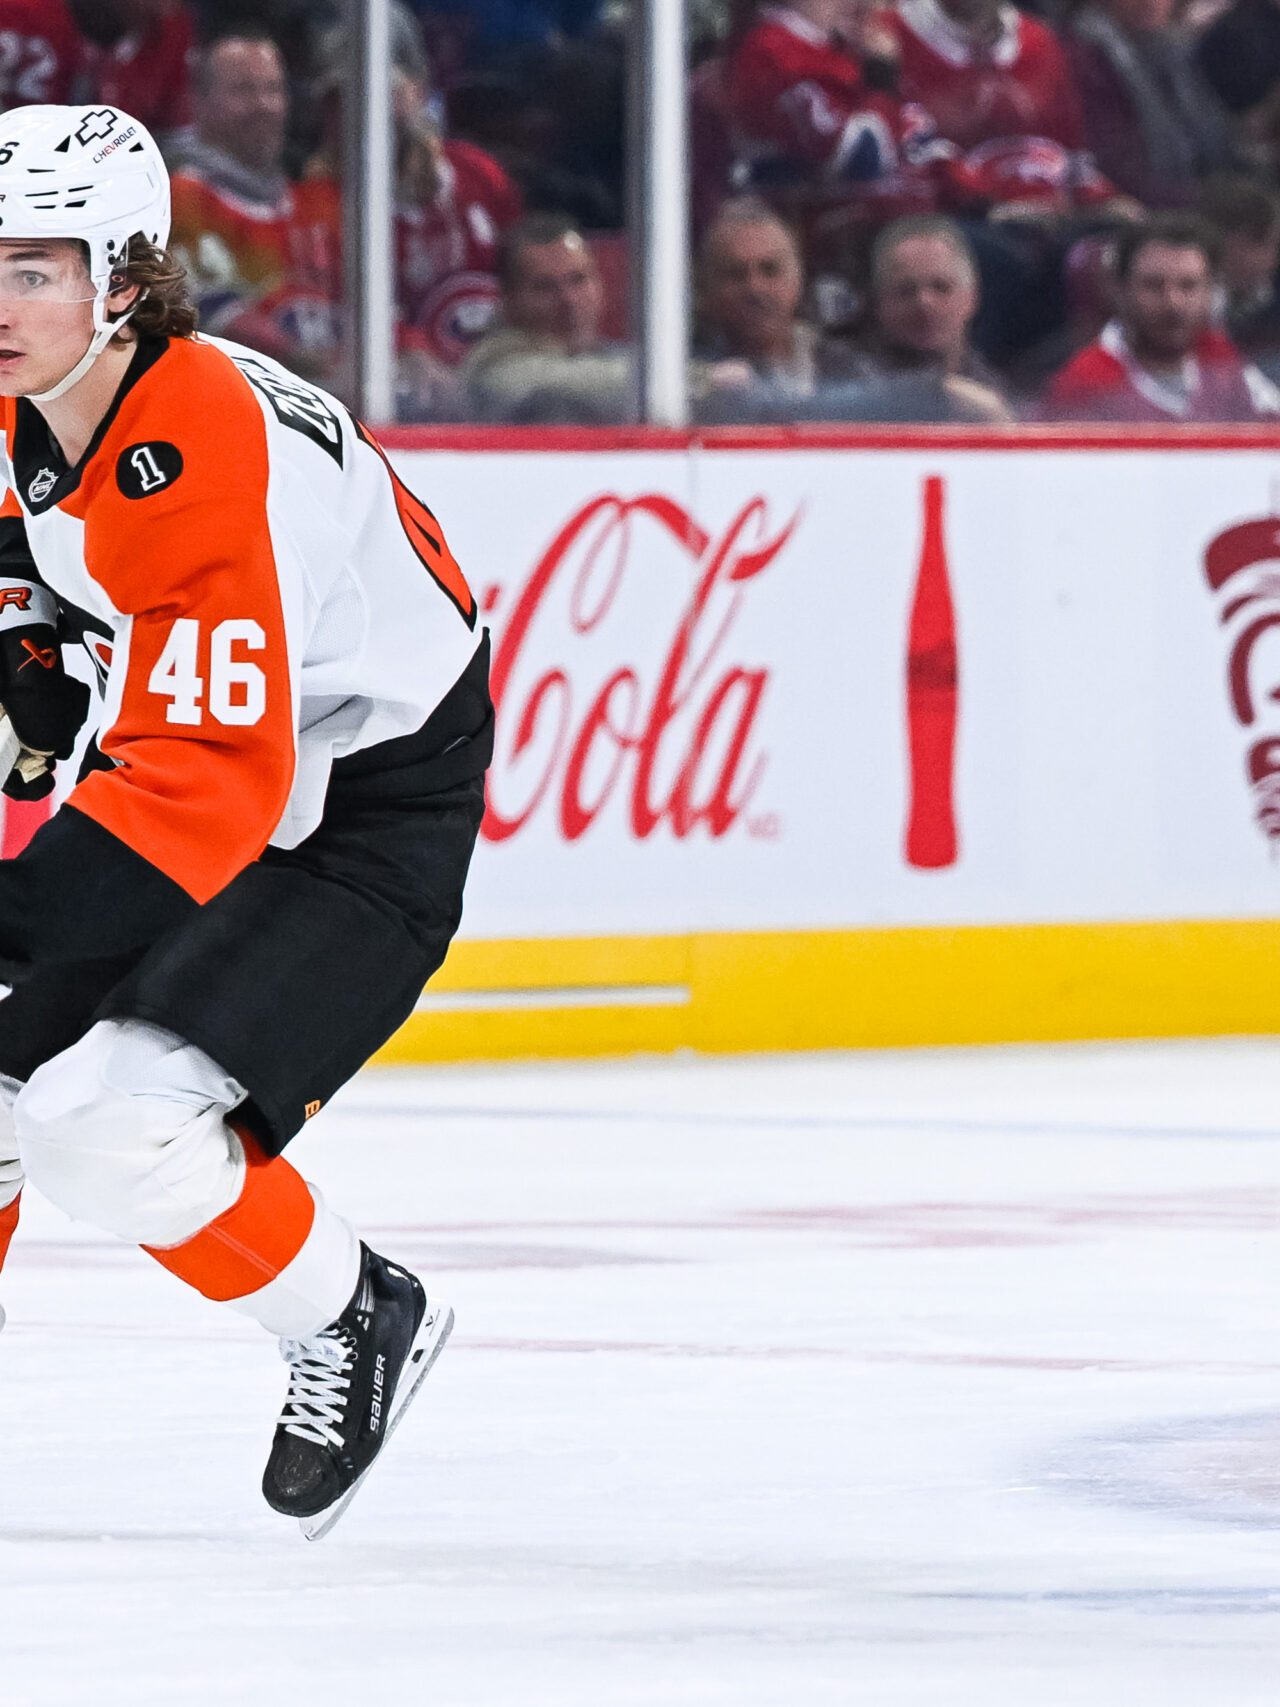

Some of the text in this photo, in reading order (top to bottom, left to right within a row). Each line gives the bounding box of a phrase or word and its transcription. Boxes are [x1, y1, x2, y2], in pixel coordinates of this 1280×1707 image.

[93, 126, 137, 164] CHEVROLET
[130, 446, 167, 492] 1
[147, 617, 266, 726] 46
